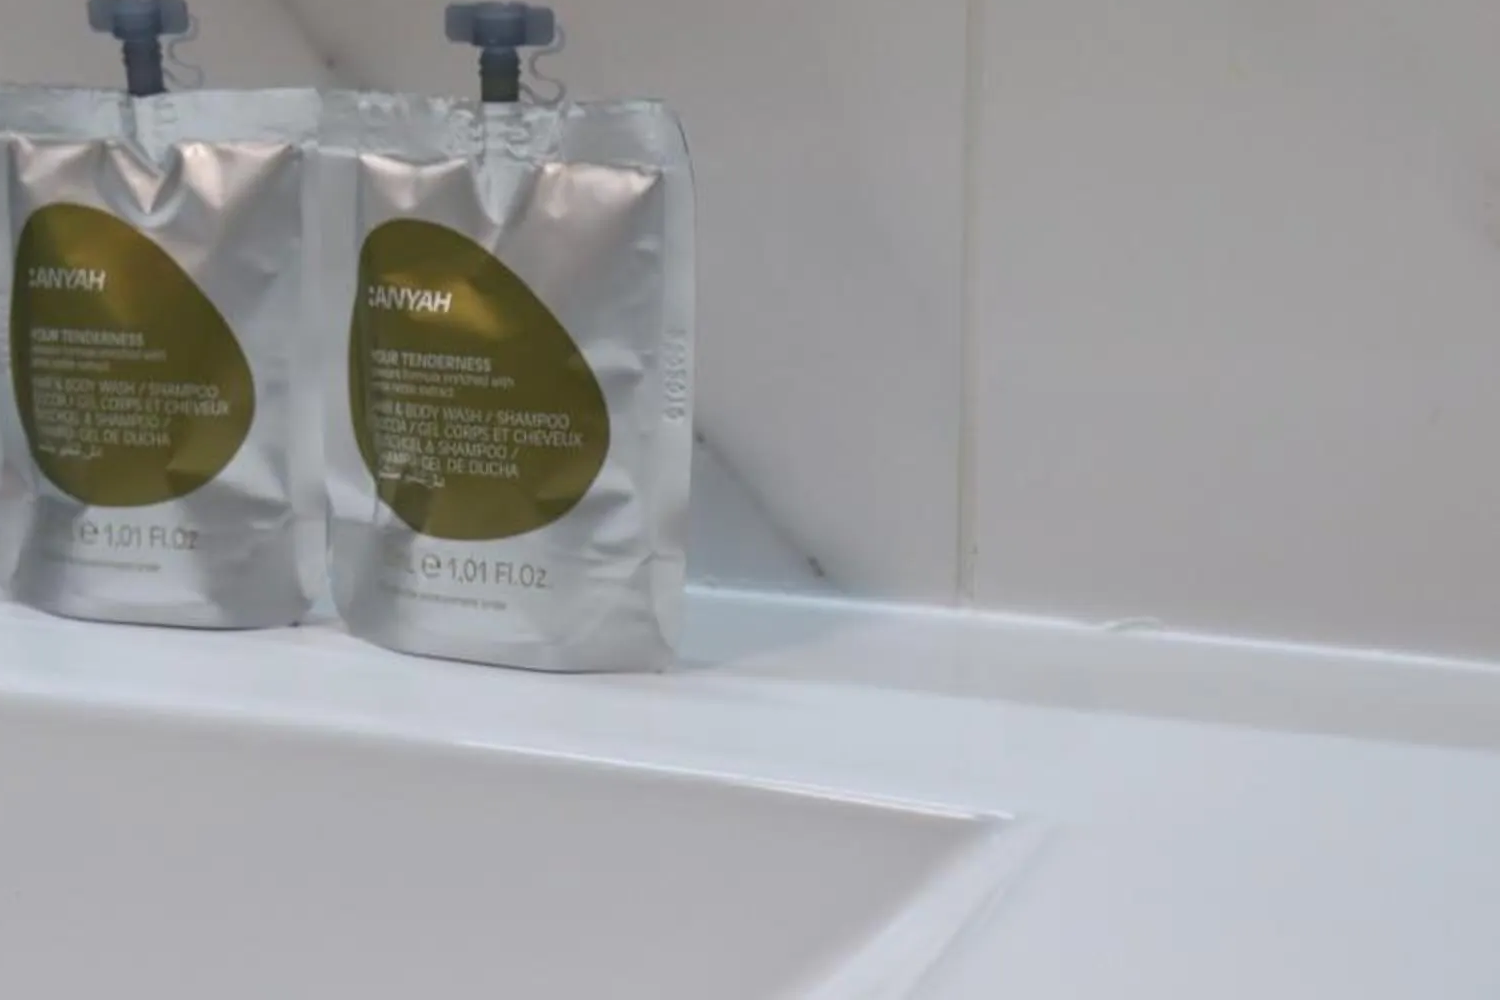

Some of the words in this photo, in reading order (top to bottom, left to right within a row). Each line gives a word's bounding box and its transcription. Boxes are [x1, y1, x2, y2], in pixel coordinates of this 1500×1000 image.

[401, 351, 492, 373] TENDERNESS
[99, 379, 137, 396] WASH
[148, 381, 220, 400] SHAMPOO
[405, 402, 440, 419] BODY
[443, 405, 483, 423] WASH
[496, 409, 570, 430] SHAMPOO
[417, 420, 440, 438] GEL
[443, 423, 490, 442] CORPS
[493, 427, 511, 443] ET
[513, 428, 586, 448] CHEVEUX
[436, 439, 507, 460] SHAMPOO
[420, 455, 442, 471] GEL
[446, 457, 465, 473] DE
[468, 458, 520, 479] DUCHA
